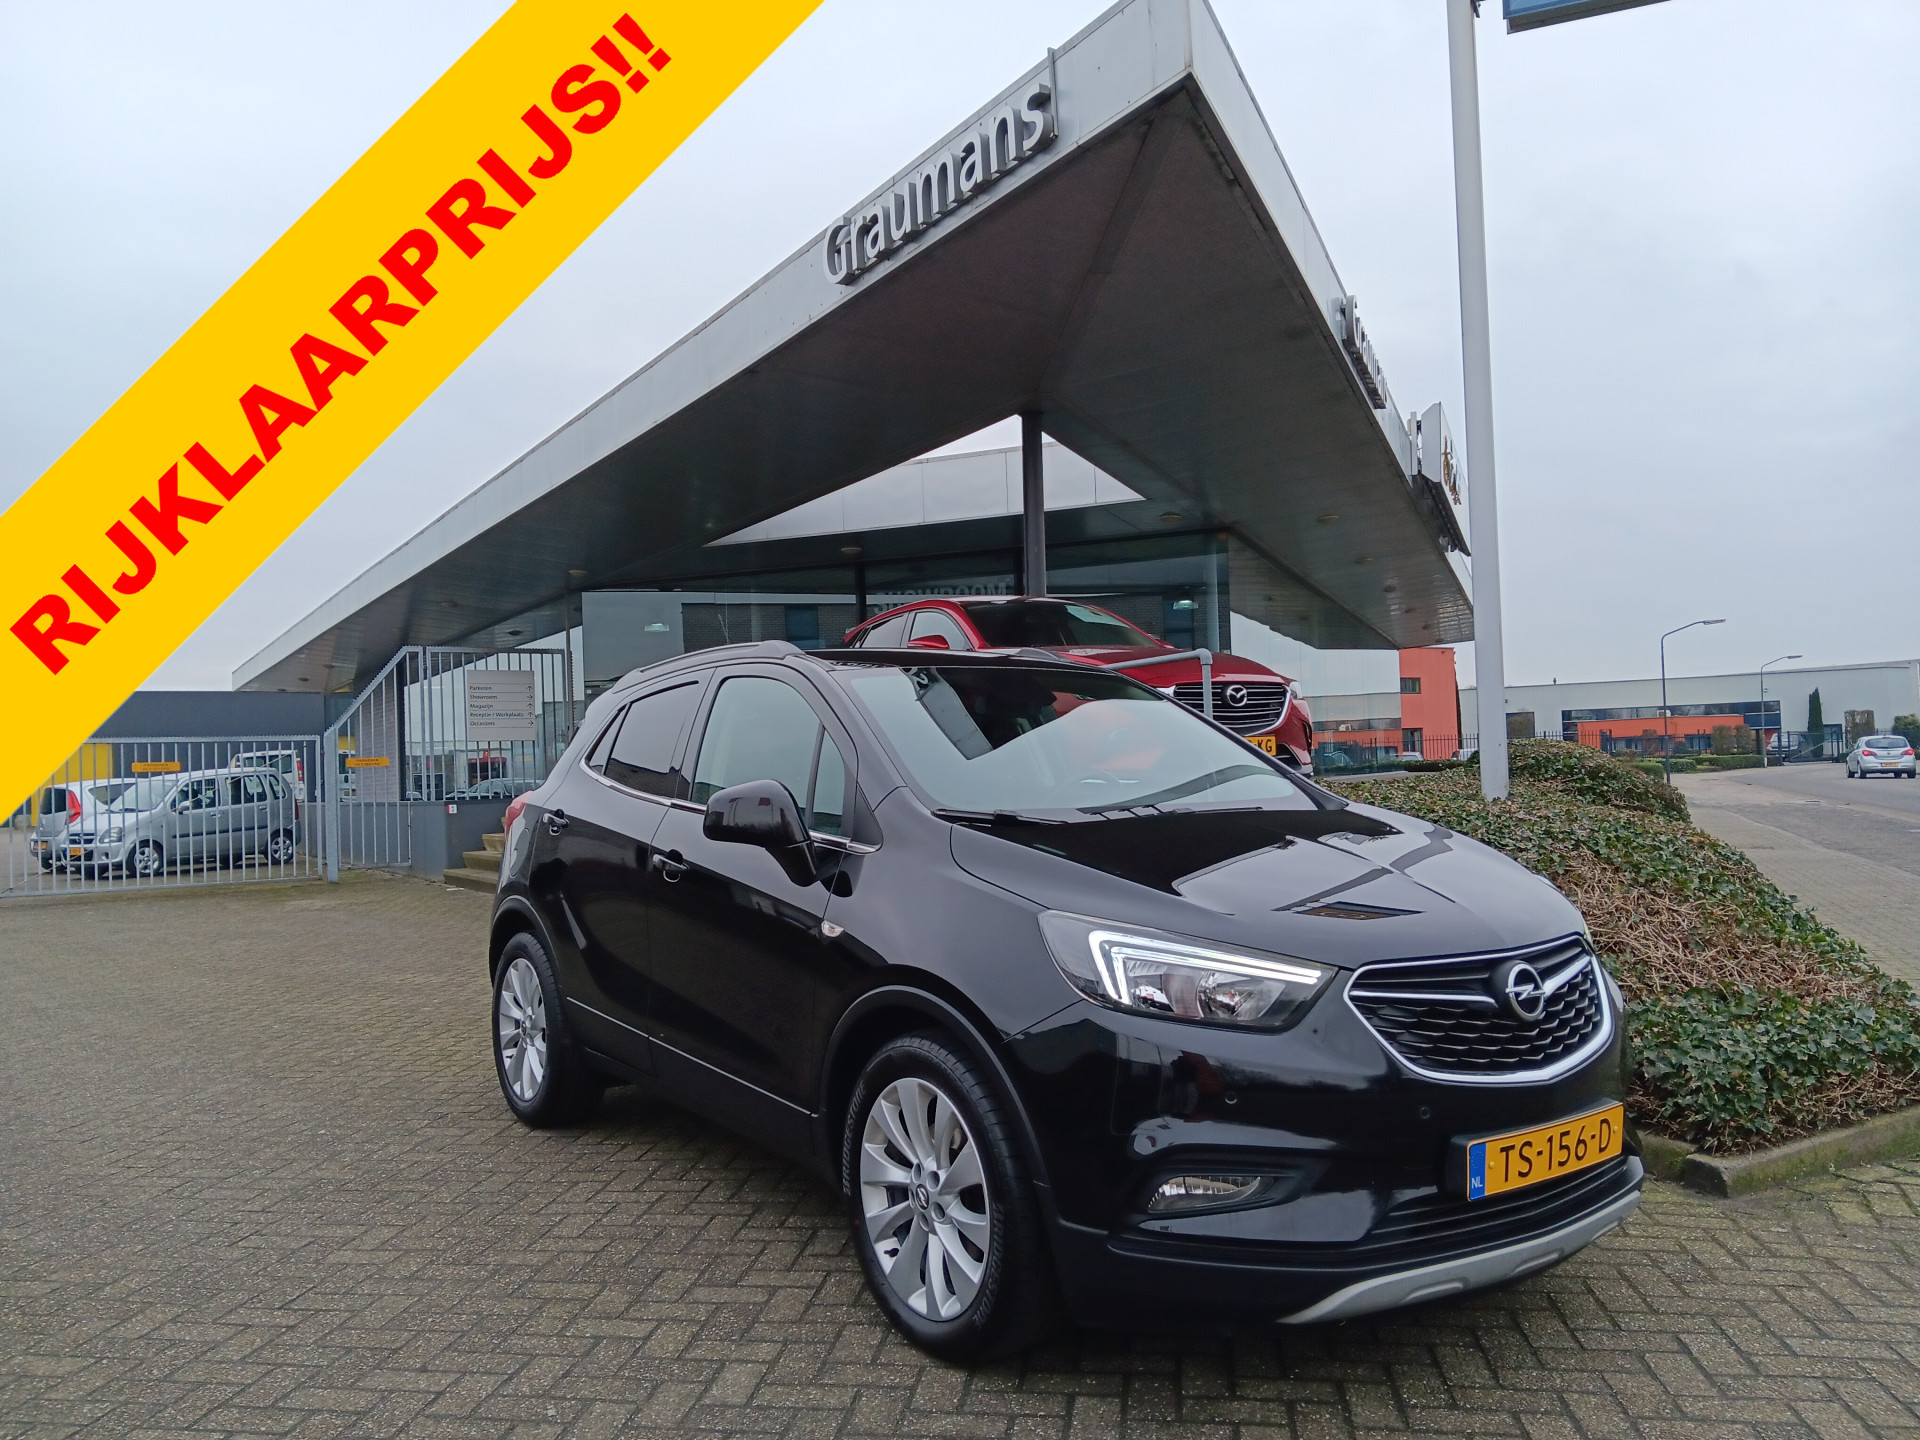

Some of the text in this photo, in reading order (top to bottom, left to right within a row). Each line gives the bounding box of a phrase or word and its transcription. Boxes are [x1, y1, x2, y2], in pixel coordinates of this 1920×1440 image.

[822, 82, 1054, 286] Graumans
[842, 1079, 867, 1197] BRIDGESTONE
[1471, 1175, 1484, 1189] NL
[1499, 1118, 1612, 1183] TS-156-D
